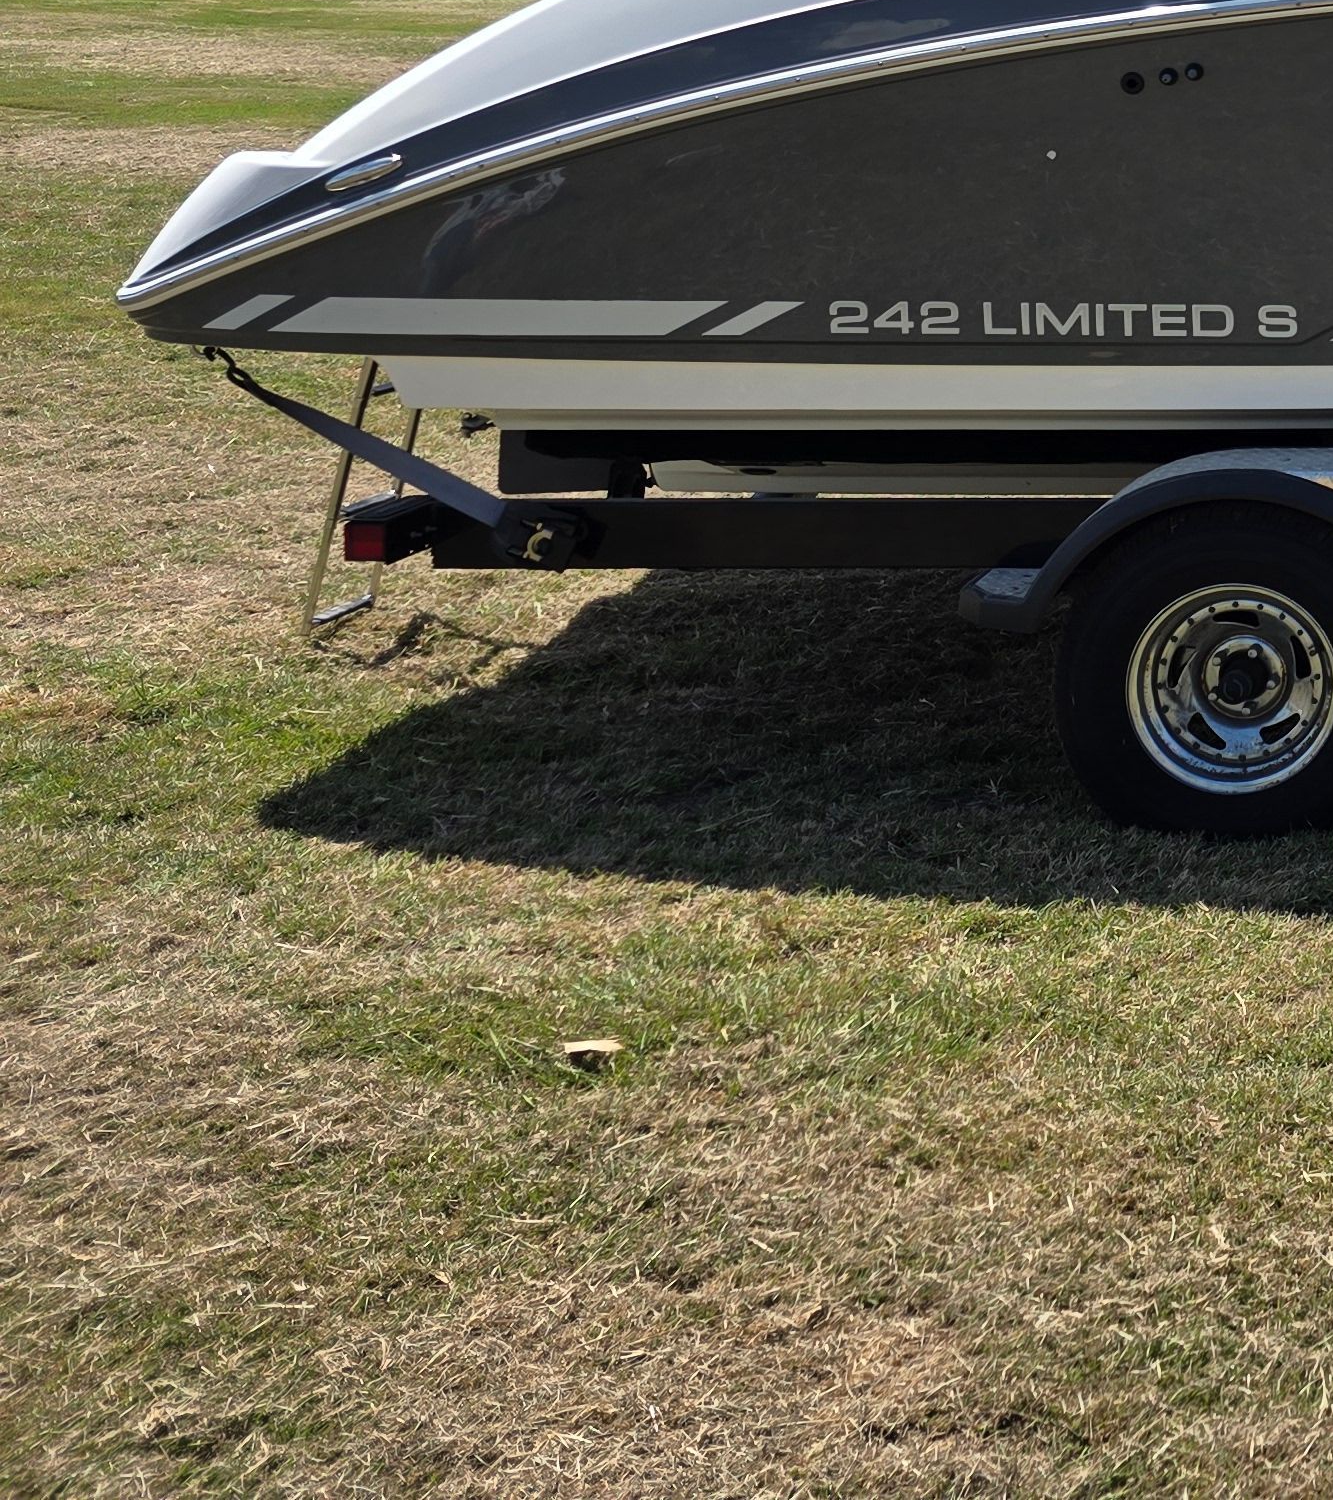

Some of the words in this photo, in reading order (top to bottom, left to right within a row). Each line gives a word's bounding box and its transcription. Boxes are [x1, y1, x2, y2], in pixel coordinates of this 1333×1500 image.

[829, 301, 960, 334] 242
[983, 302, 1234, 337] LIMITED
[1258, 305, 1298, 338] S
